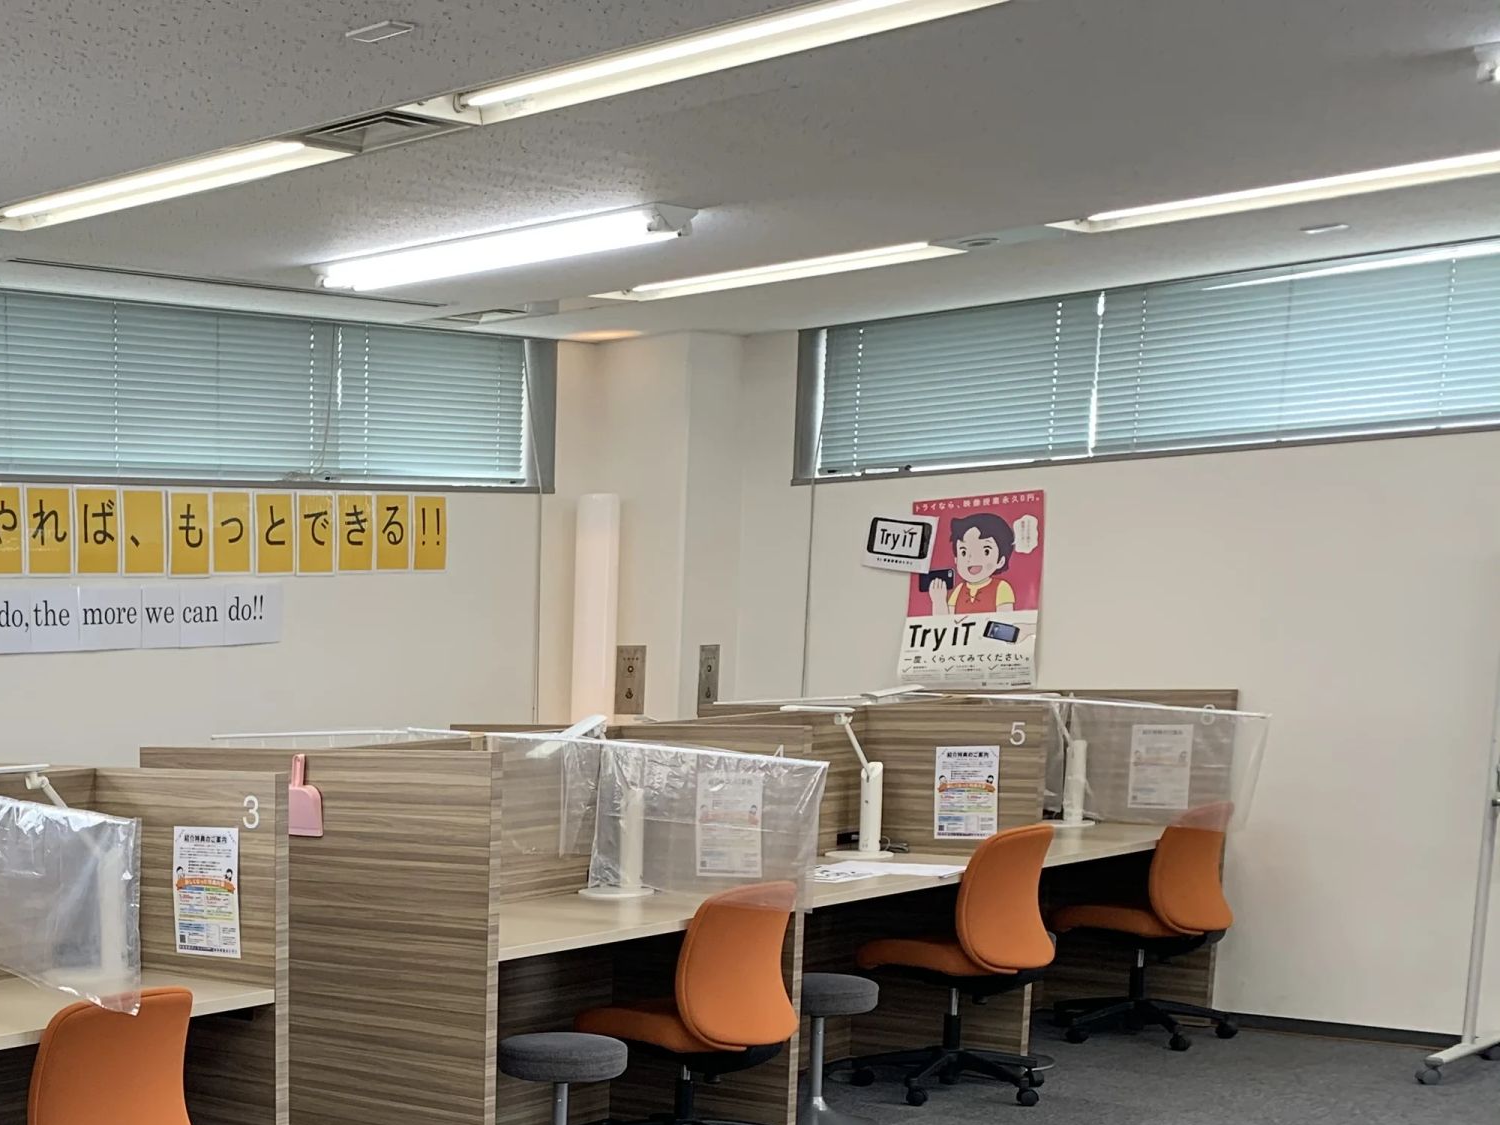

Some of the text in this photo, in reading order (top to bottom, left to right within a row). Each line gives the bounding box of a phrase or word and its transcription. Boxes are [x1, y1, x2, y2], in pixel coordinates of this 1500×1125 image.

[880, 528, 900, 550] Try
[33, 600, 70, 627] the
[82, 605, 137, 625] more
[145, 605, 175, 624] we
[182, 604, 219, 624] can
[228, 594, 264, 621] do!!
[908, 621, 976, 651] Try iT
[1009, 722, 1026, 746] 5
[242, 795, 260, 829] 3
